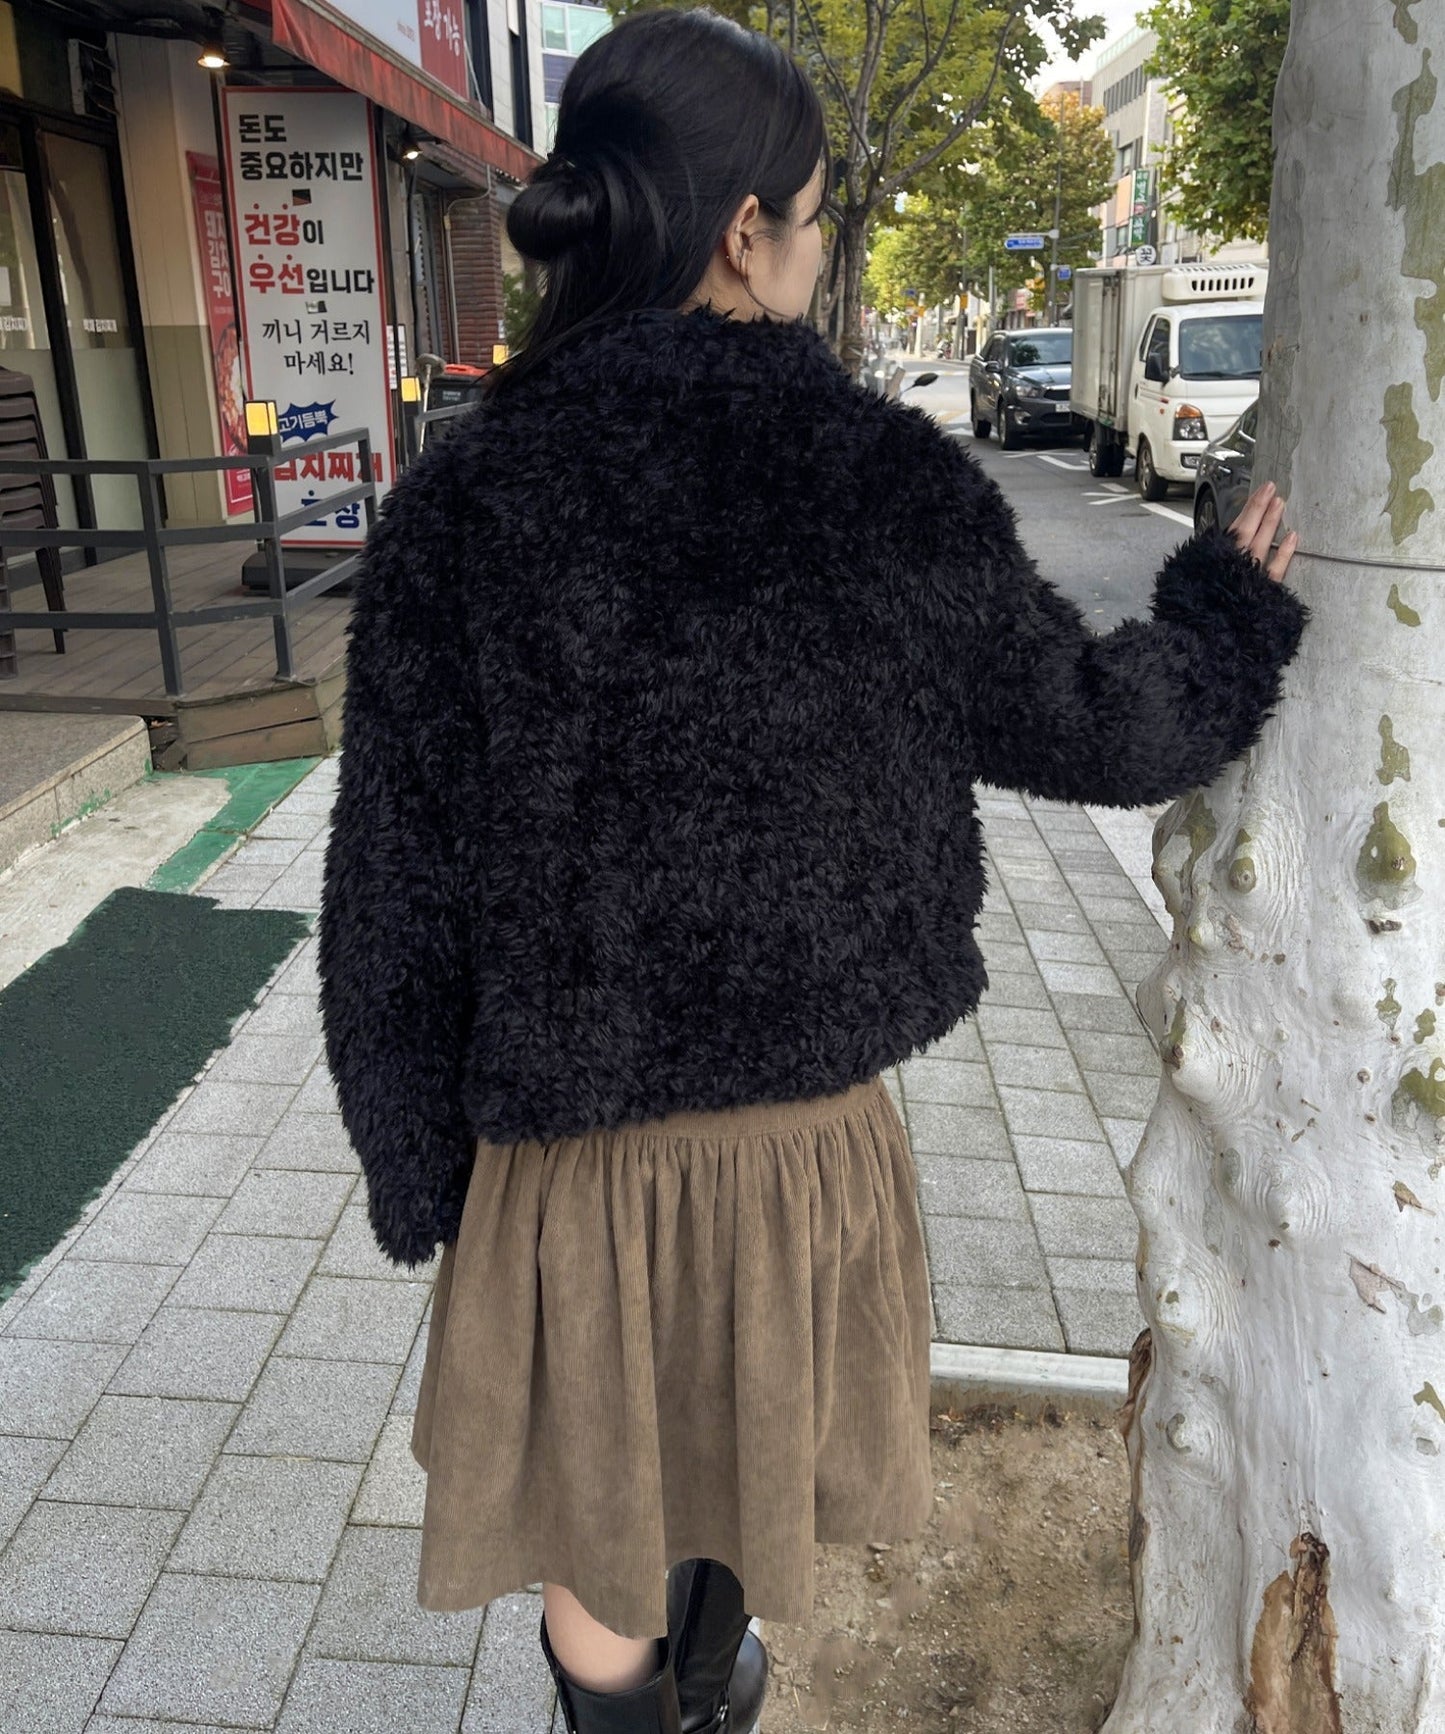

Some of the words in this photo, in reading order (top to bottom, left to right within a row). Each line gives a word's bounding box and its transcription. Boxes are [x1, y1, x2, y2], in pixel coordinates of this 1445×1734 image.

[238, 114, 287, 143] 돈도
[240, 151, 363, 181] 중요하지만
[244, 213, 324, 246] 건강이
[249, 262, 375, 294] 우선입니다
[262, 319, 302, 344] 끼니
[310, 320, 371, 345] 거르지
[284, 351, 354, 376] 마세요!
[279, 410, 328, 433] 고기듬뿍
